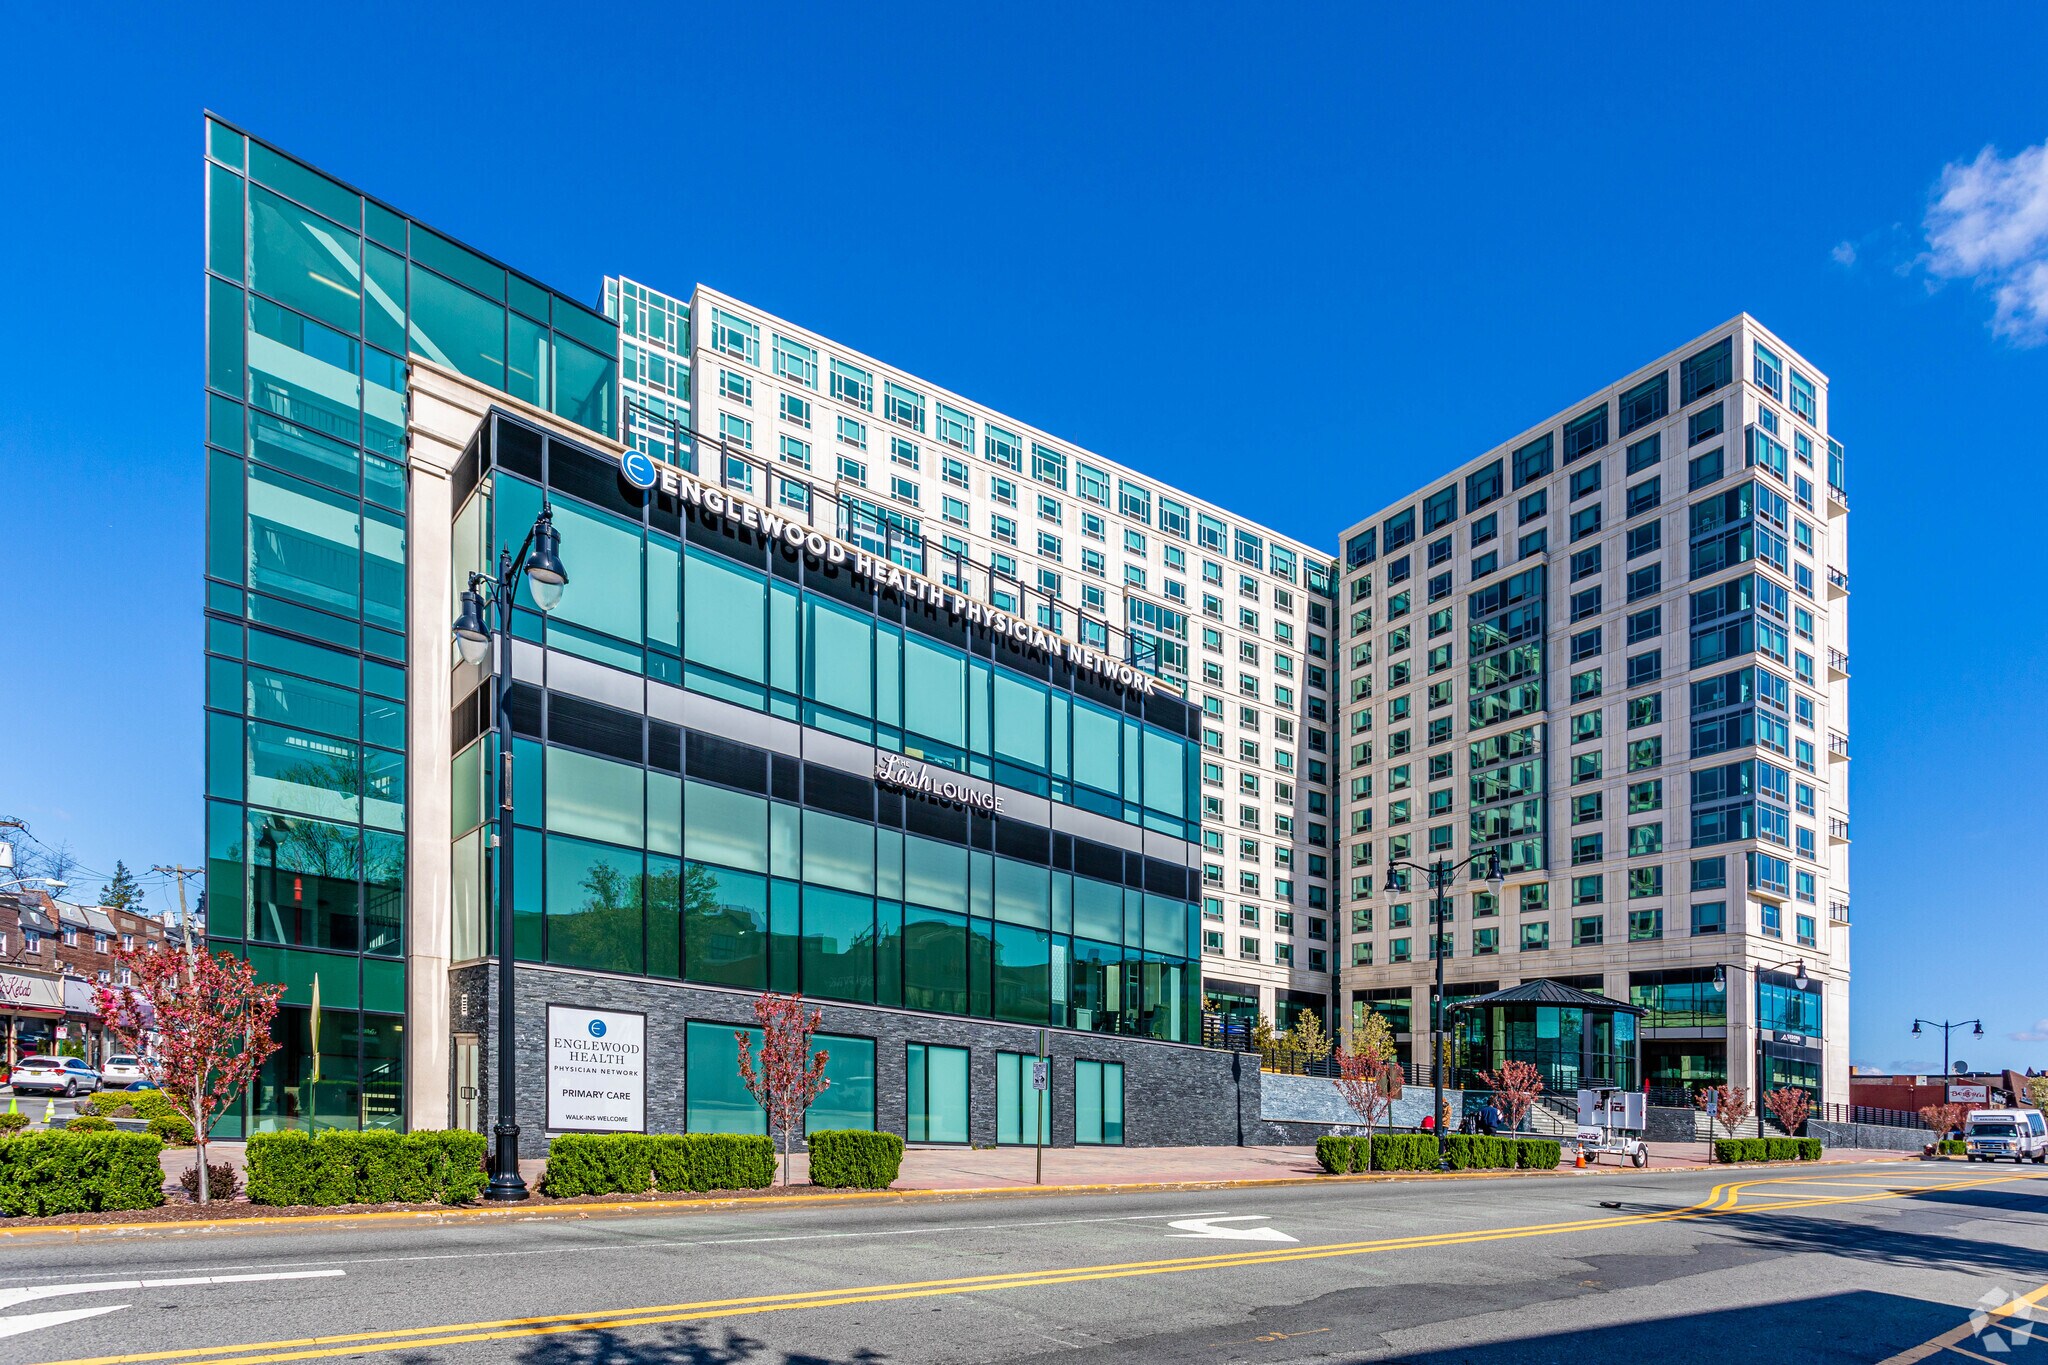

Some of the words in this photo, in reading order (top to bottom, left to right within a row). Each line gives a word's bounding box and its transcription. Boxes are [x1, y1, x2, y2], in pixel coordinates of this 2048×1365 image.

[660, 467, 846, 564] ENGLEWOOD
[855, 553, 944, 608] HEALTH
[953, 597, 1061, 656] PHYSICIAN
[1068, 643, 1155, 695] NETWORK
[879, 754, 931, 792] Lash
[932, 778, 1005, 813] LOUNGE
[7, 976, 33, 998] Kebab
[554, 1038, 640, 1054] ENGLEWOOD
[570, 1051, 625, 1065] HEALTH
[554, 1065, 597, 1074] PHYSICIAN
[600, 1068, 639, 1077] NETWORK
[562, 1088, 604, 1099] PRIMARY
[606, 1091, 631, 1101] CARE
[1594, 1104, 1626, 1112] POICE
[597, 1115, 629, 1123] WELCOME
